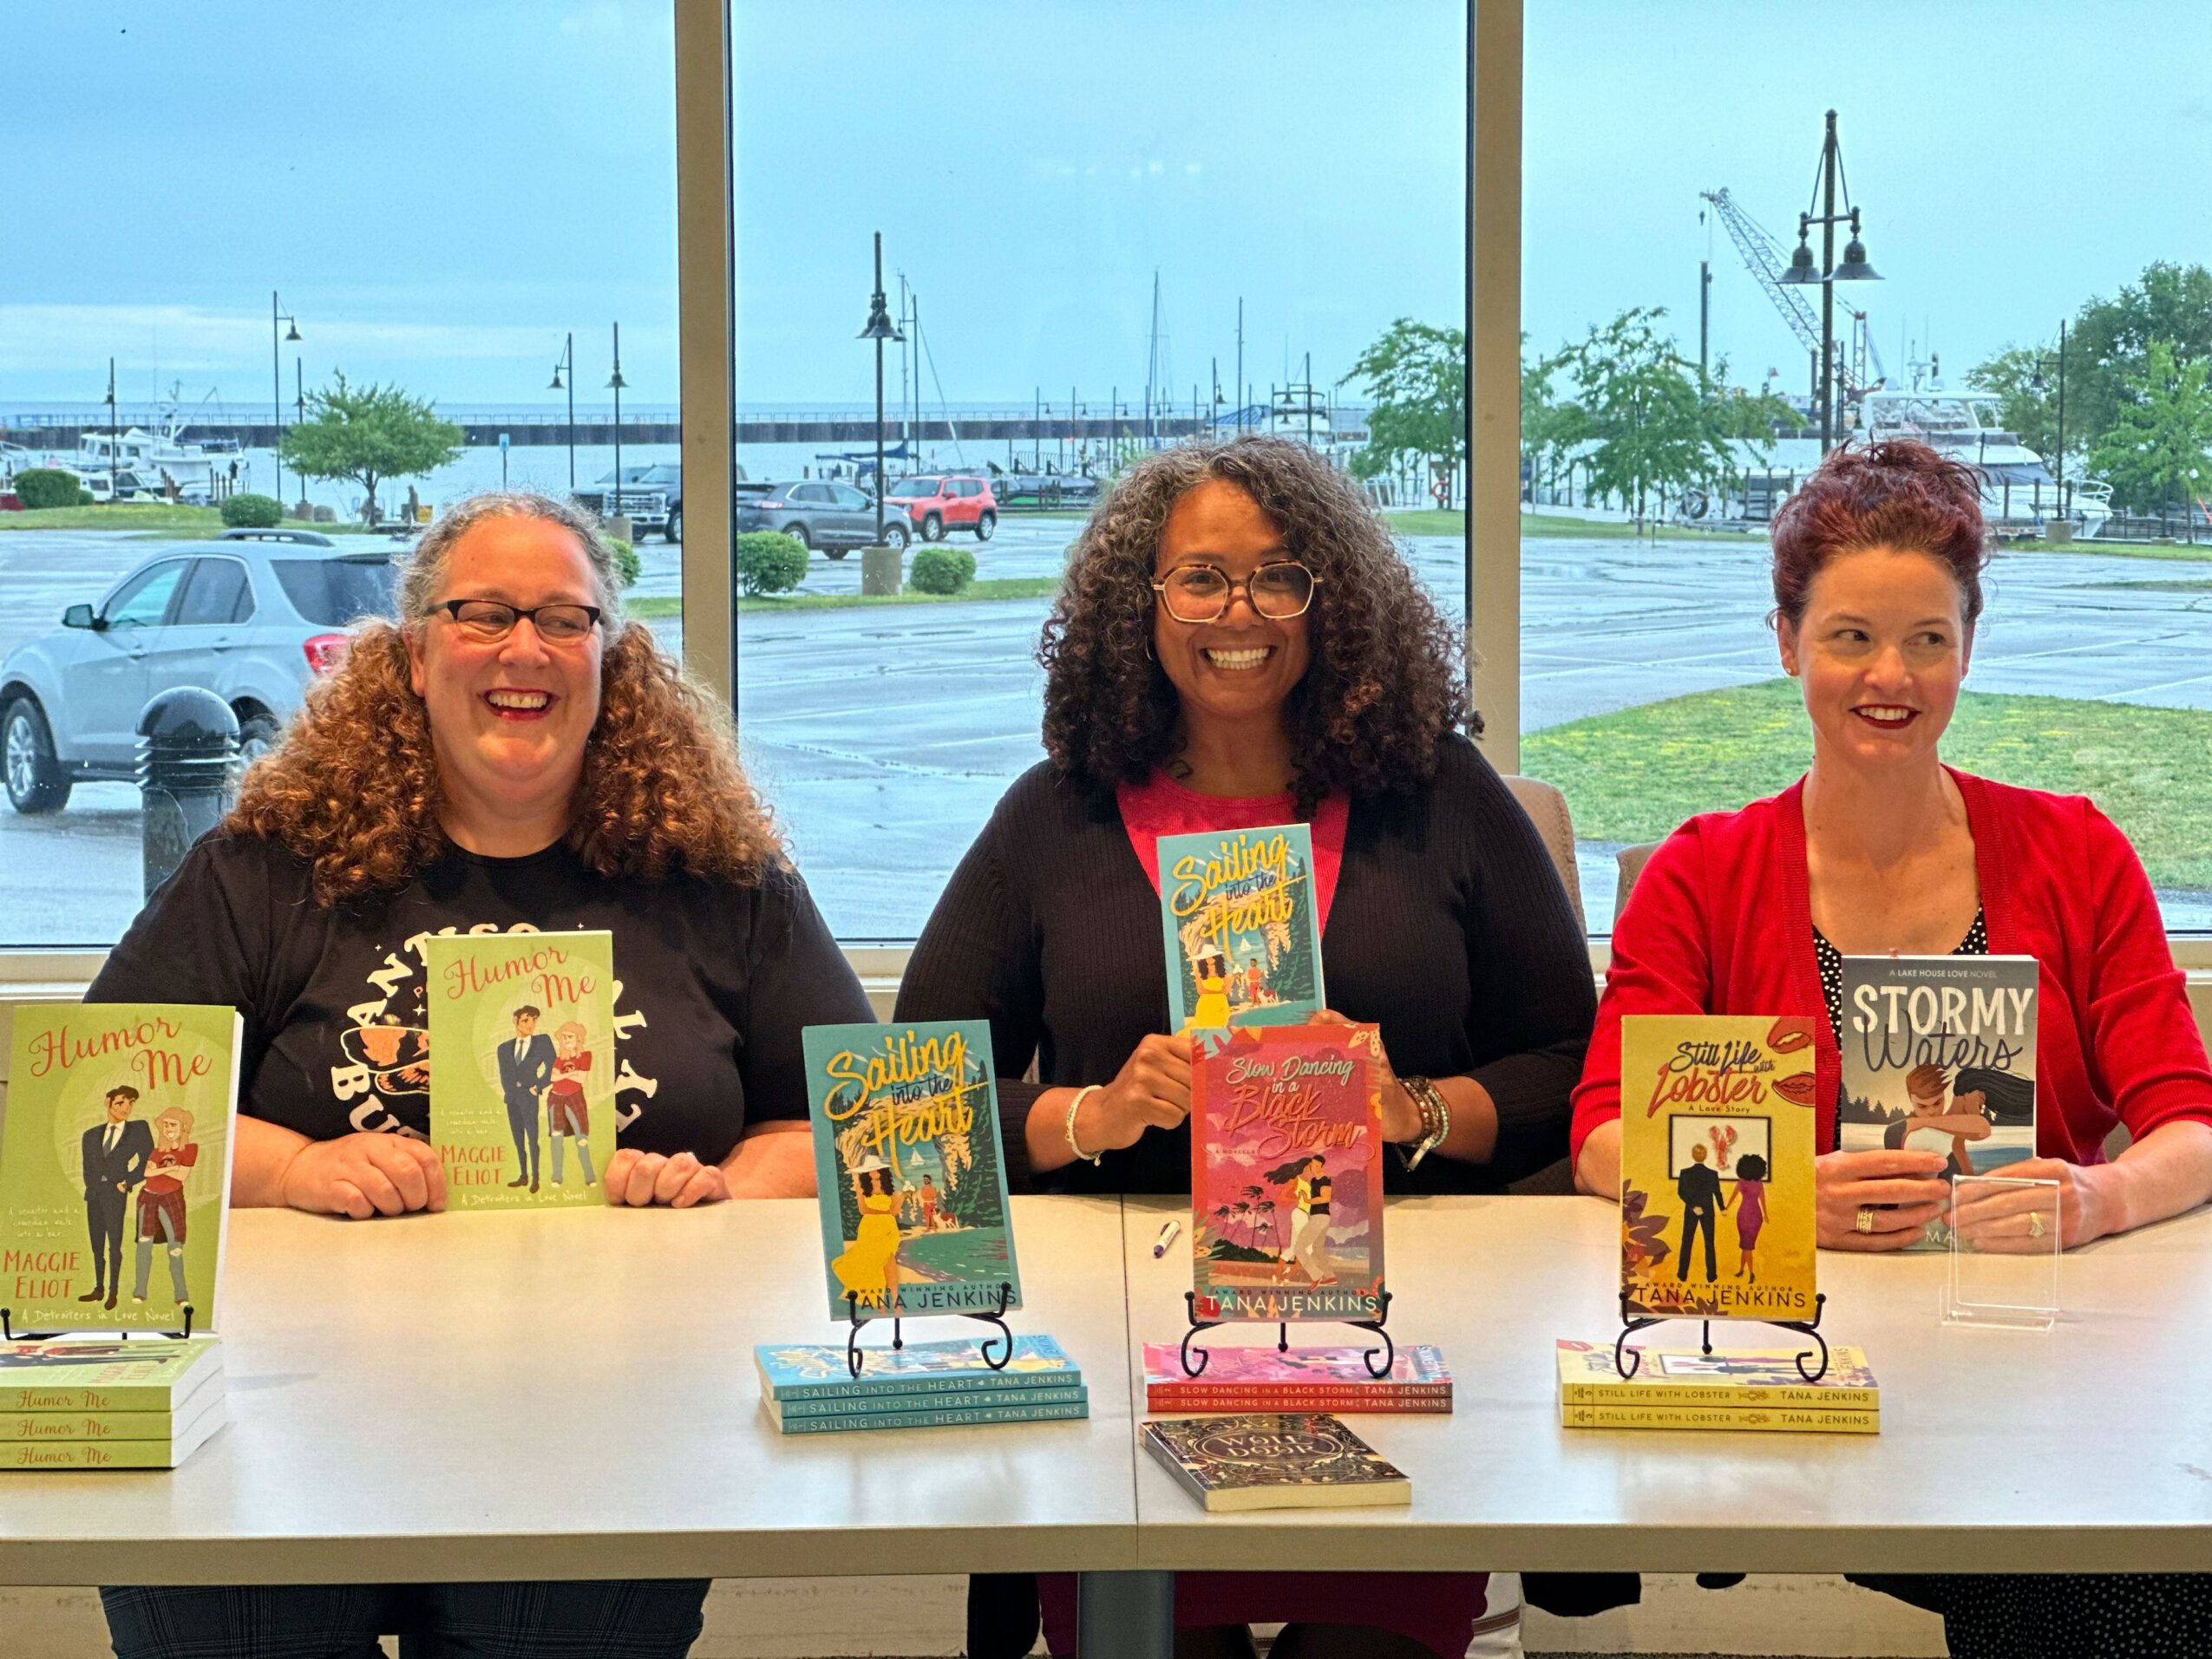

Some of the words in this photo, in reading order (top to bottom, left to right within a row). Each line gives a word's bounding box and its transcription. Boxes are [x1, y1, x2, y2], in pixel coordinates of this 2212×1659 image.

[1170, 833, 1290, 917] Sailing
[1226, 883, 1250, 901] into
[1255, 872, 1278, 889] the
[1200, 874, 1307, 963] Heart
[443, 945, 569, 1001] Humor
[1888, 969, 1896, 977] A
[1897, 969, 1917, 977] LAKE
[1947, 970, 1968, 978] LOVE
[1970, 970, 1998, 979] NOVEL
[531, 972, 597, 1009] Me
[1852, 983, 2034, 1035] STORMY
[29, 1016, 181, 1078] Humor
[1863, 1009, 2023, 1072] Waters
[130, 1048, 213, 1091] Me
[1225, 1057, 1275, 1084] Slow
[1280, 1054, 1356, 1087] Dancing
[1668, 1041, 1720, 1073] Still
[1719, 1040, 1762, 1077] Life
[1753, 1060, 1777, 1074] with
[824, 1029, 968, 1120] Sailing
[1272, 1078, 1286, 1094] in
[1288, 1081, 1300, 1093] a
[892, 1085, 923, 1106] into
[928, 1074, 954, 1094] the
[1646, 1061, 1768, 1119] Lobster
[1224, 1084, 1324, 1139] Black
[1698, 1104, 1721, 1113] Love
[1725, 1105, 1751, 1114] Story
[861, 1081, 989, 1179] Heart
[1258, 1115, 1363, 1160] Storm
[441, 1144, 507, 1165] MAGGIE
[453, 1166, 504, 1186] ELIOT
[461, 1193, 468, 1206] A
[538, 1192, 558, 1203] Love
[562, 1190, 588, 1201] Novel
[3, 1249, 82, 1274] MAGGIE
[15, 1275, 74, 1300] ELIOT
[900, 1284, 955, 1293] WINNING
[962, 1283, 1004, 1291] AUTHO
[1636, 1287, 1696, 1303] TANA
[1705, 1290, 1806, 1308] JENKINS
[846, 1293, 907, 1311] ANA
[917, 1290, 1018, 1310] JENKINS
[1205, 1296, 1267, 1311] TANA
[1277, 1296, 1378, 1311] JENKINS
[21, 1310, 29, 1323] A
[32, 1309, 91, 1323] Detroiters
[98, 1310, 108, 1321] in
[115, 1310, 139, 1323] Love
[145, 1308, 175, 1323] Novel
[802, 1385, 861, 1398] SAILING
[867, 1384, 895, 1394] INTO
[900, 1382, 922, 1393] THE
[928, 1379, 974, 1391] HEART
[990, 1375, 1021, 1387] TANA
[1024, 1374, 1074, 1386] JENKINS
[1364, 1386, 1394, 1394] TANA
[1397, 1386, 1447, 1394] JENKINS
[1598, 1389, 1626, 1398] STILL
[1630, 1389, 1651, 1398] LIFE
[1685, 1390, 1731, 1399] LOBSTER
[1779, 1390, 1812, 1401] TANA
[1816, 1391, 1870, 1401] JENKINS
[16, 1390, 75, 1408] Humor
[81, 1390, 111, 1408] Me
[808, 1401, 868, 1414] SAILING
[873, 1401, 902, 1410] INTO
[906, 1399, 930, 1408] THE
[934, 1394, 980, 1407] HEART
[997, 1393, 1026, 1403] TANA
[1031, 1390, 1080, 1401] JENKINS
[1365, 1399, 1394, 1408] TANA
[1398, 1399, 1447, 1408] JENKINS
[17, 1419, 75, 1436] Humor
[82, 1419, 112, 1436] Me
[810, 1418, 868, 1431] SAILING
[874, 1418, 902, 1427] INTO
[908, 1416, 931, 1426] THE
[935, 1411, 981, 1423] HEART
[998, 1409, 1028, 1420] TANA
[1031, 1406, 1081, 1418] JENKINS
[1656, 1413, 1681, 1421] WITH
[1685, 1414, 1731, 1422] LOBSTER
[1780, 1414, 1813, 1423] TANA
[1817, 1414, 1870, 1425] JENKINS
[17, 1447, 75, 1464] Humor
[82, 1447, 112, 1464] Me
